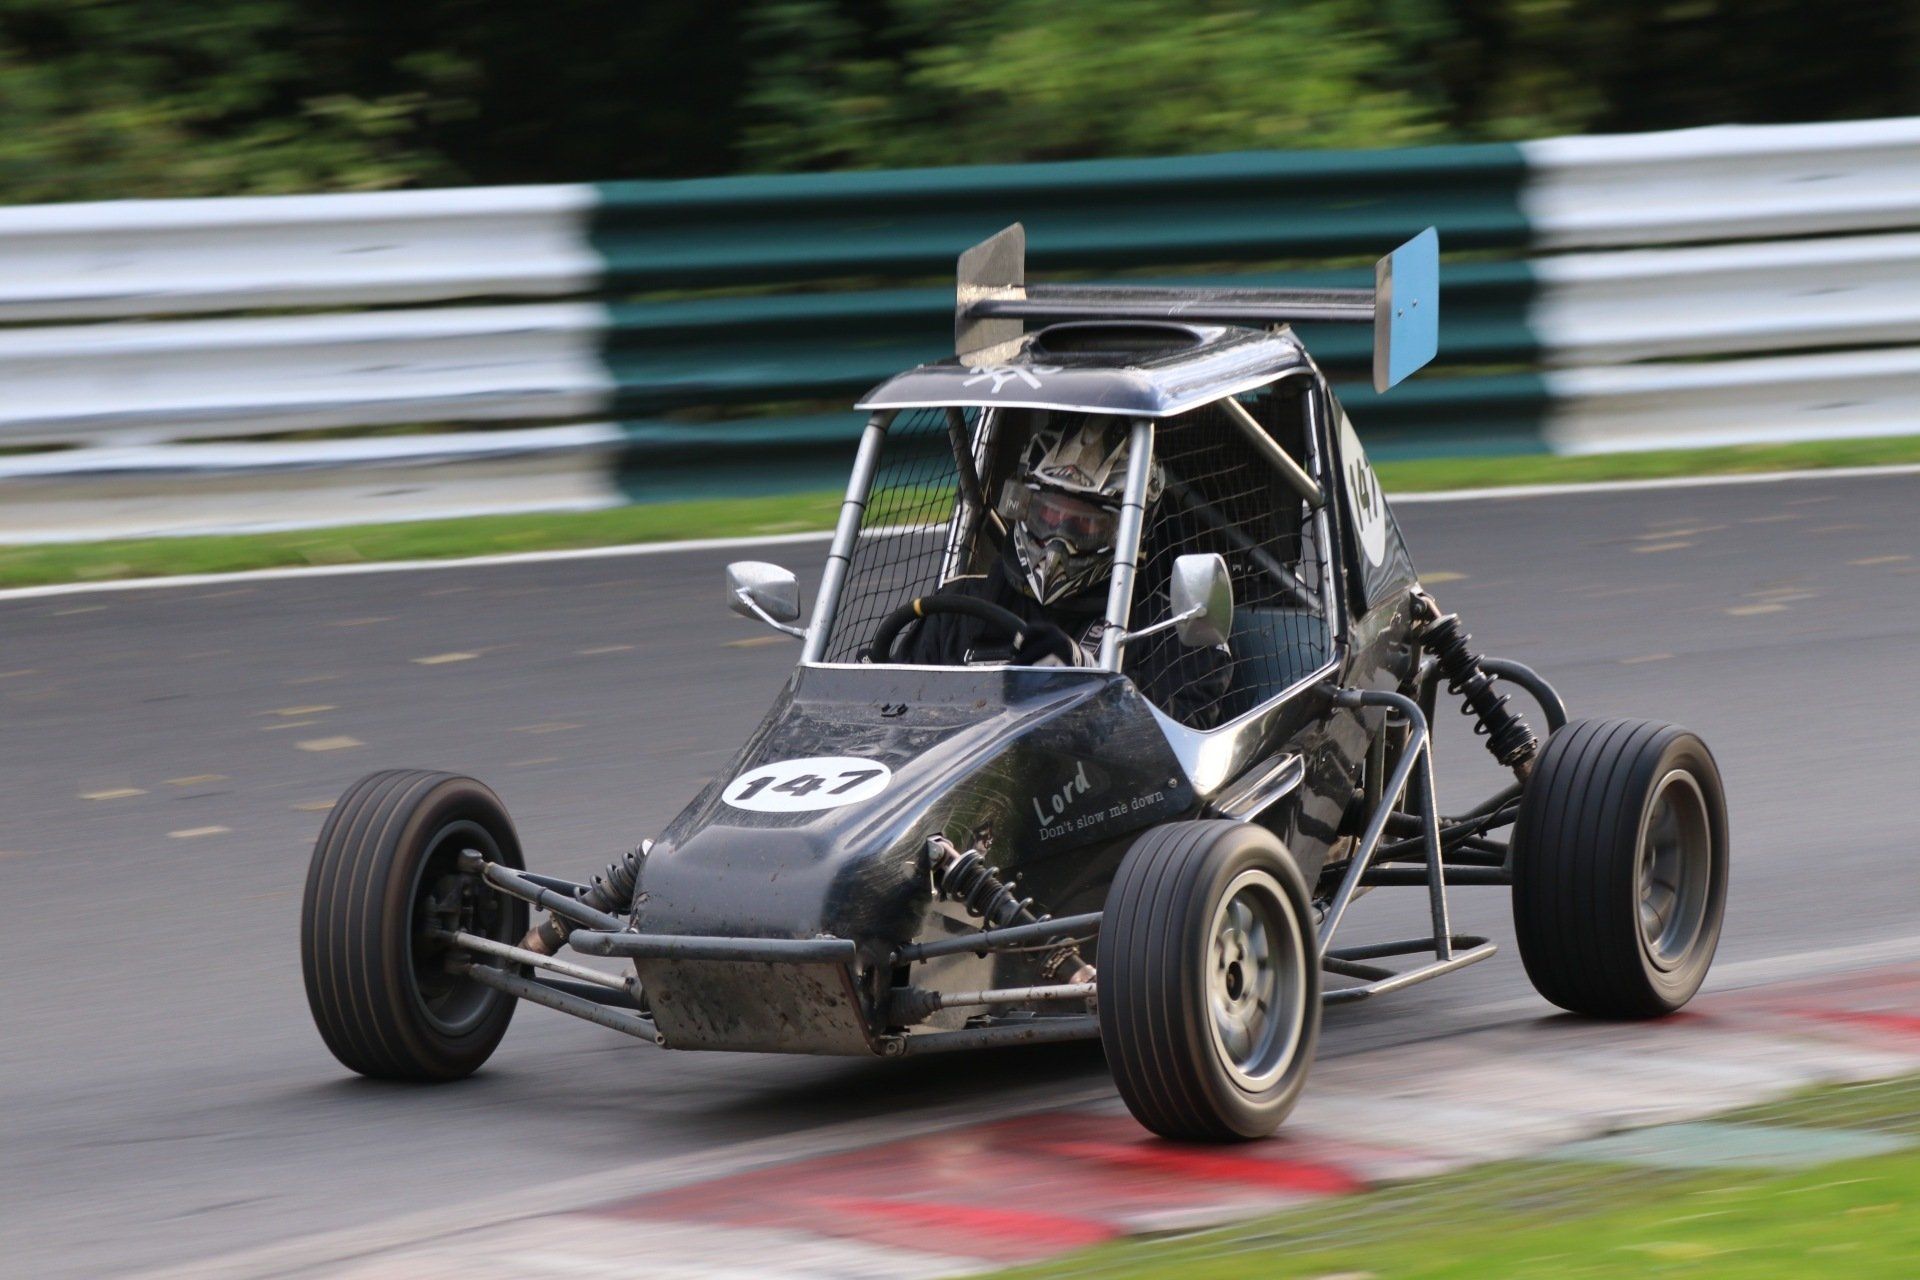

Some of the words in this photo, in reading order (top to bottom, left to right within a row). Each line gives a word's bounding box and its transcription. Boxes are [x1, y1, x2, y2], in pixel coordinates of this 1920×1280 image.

[1350, 456, 1377, 532] 147
[734, 769, 883, 800] 147
[1033, 761, 1091, 826] Lord
[1040, 822, 1074, 840] Don't
[1077, 814, 1106, 829] slow
[1109, 803, 1128, 818] me
[1131, 791, 1165, 810] down
